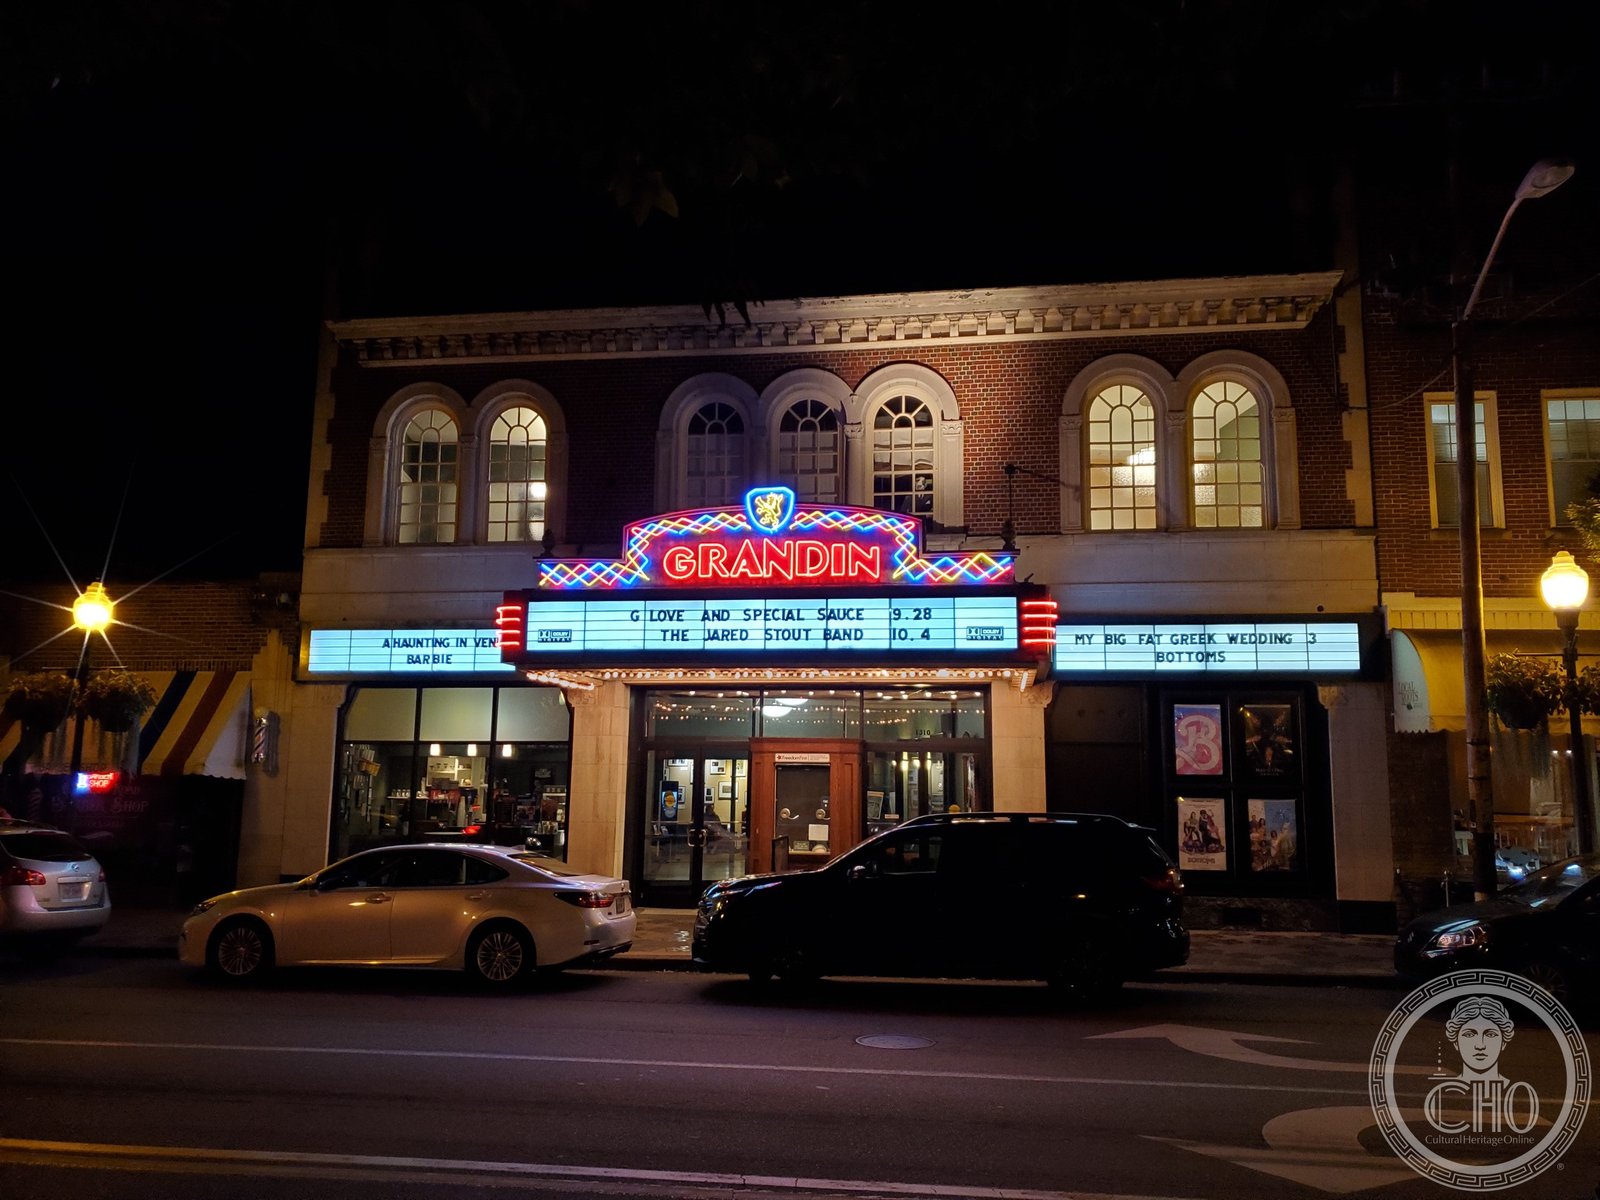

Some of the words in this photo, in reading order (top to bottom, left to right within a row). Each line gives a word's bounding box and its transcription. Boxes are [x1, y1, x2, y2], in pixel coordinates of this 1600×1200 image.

[663, 538, 880, 580] GRANDIN
[630, 610, 640, 622] G
[649, 609, 685, 622] LOVE
[701, 609, 730, 621] AND
[743, 608, 805, 621] SPECIAL
[817, 608, 865, 621] SAUCE
[892, 608, 932, 620] 9.28
[660, 629, 689, 641] THE
[703, 629, 749, 641] JARED
[764, 628, 812, 641] STOUT
[823, 628, 864, 641] BAND
[1074, 633, 1095, 645] MY
[1104, 633, 1127, 645] BIG
[1138, 633, 1163, 645] FAT
[1170, 633, 1217, 645] GREEK
[1227, 633, 1293, 645] WEDDING
[1308, 632, 1317, 644] 3
[381, 637, 390, 648] A
[393, 637, 450, 648] HAUNTING
[455, 637, 468, 648] IN
[407, 654, 453, 664] BARBIE
[1156, 651, 1226, 663] BOTTOMS
[90, 780, 109, 788] SHOP
